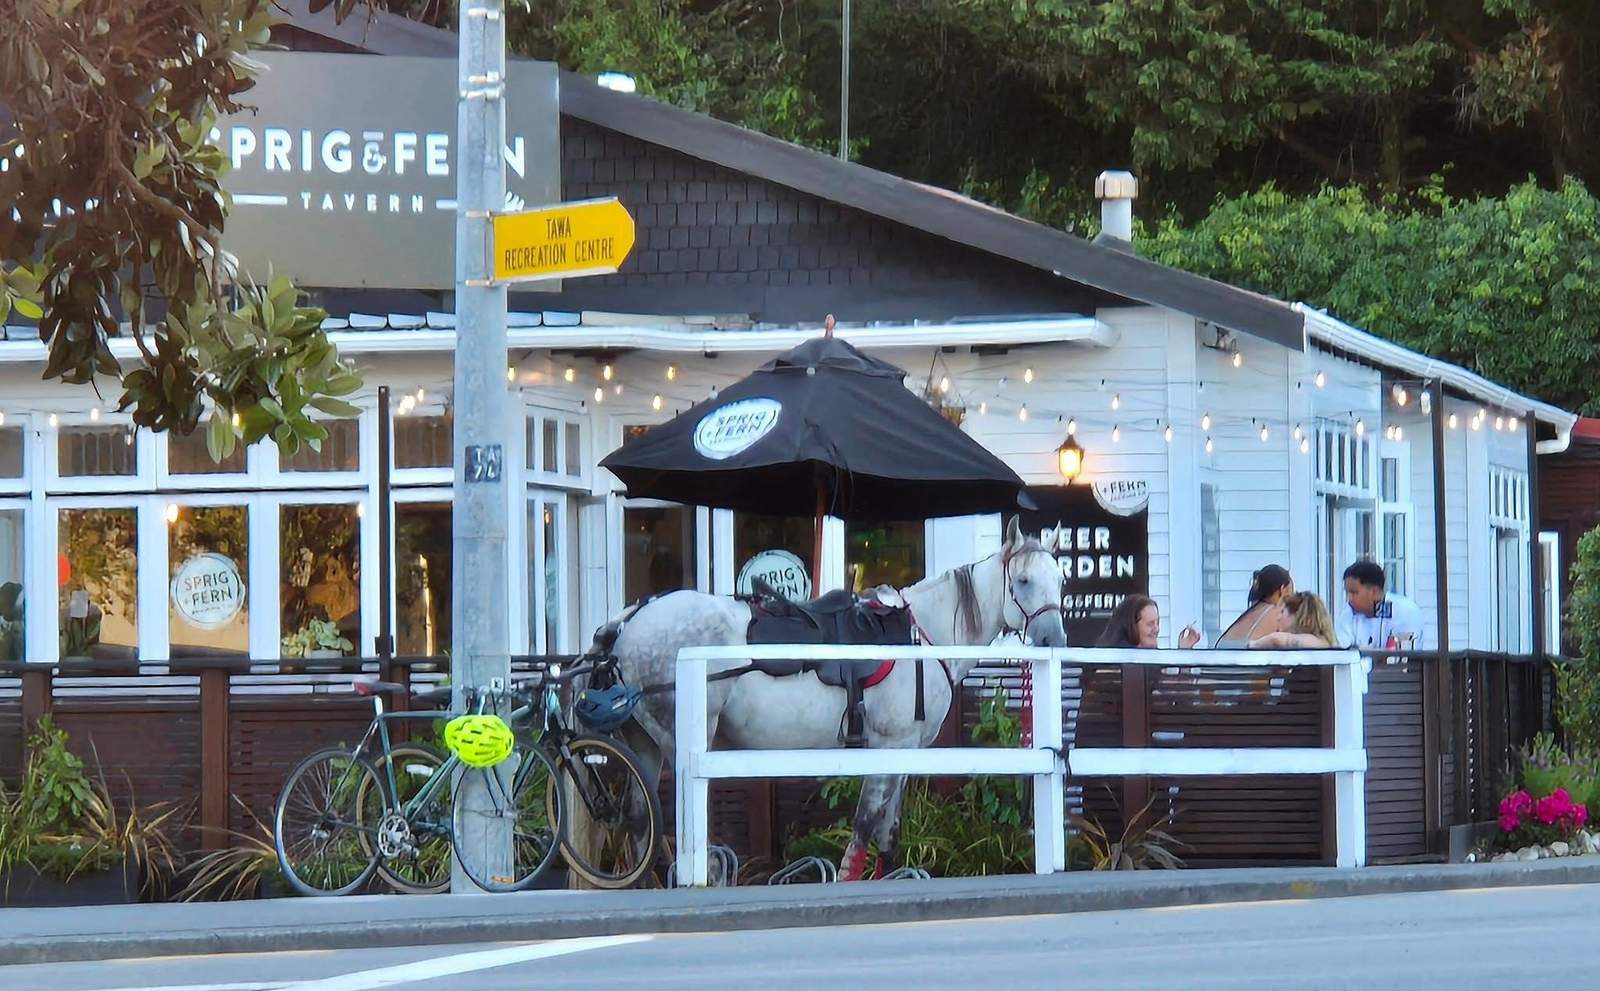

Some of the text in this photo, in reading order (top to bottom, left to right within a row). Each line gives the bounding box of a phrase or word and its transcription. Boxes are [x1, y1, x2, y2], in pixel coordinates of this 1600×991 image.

[301, 192, 425, 213] TAVERN
[545, 216, 572, 239] TAWA
[504, 237, 616, 271] RECREATION CENTRE
[716, 411, 768, 426] SPRIG
[759, 567, 795, 584] PRIG
[1057, 555, 1134, 579] RDEN
[184, 570, 229, 592] SPRIG
[776, 581, 799, 598] RN
[191, 585, 233, 607] FERN
